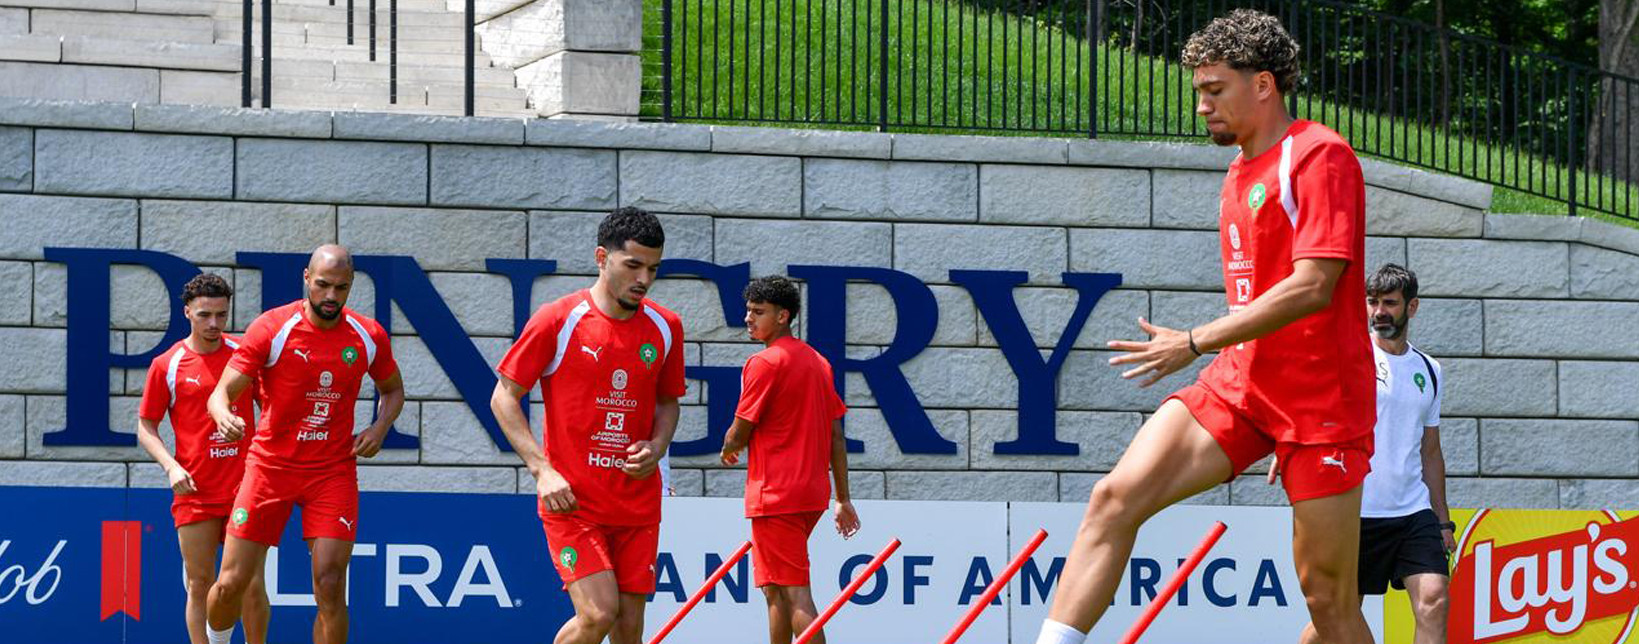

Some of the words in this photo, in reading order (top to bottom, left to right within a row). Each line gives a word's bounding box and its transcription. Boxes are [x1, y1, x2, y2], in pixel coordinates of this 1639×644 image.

[609, 390, 628, 398] VISIT
[595, 397, 638, 408] MOROCCO
[297, 430, 329, 442] Haier
[209, 446, 239, 459] Haier
[588, 452, 625, 468] Haie
[183, 543, 514, 608] LRA
[838, 553, 934, 606] OF
[957, 556, 1288, 608] AMRICA
[1473, 522, 1629, 641] Lay's
